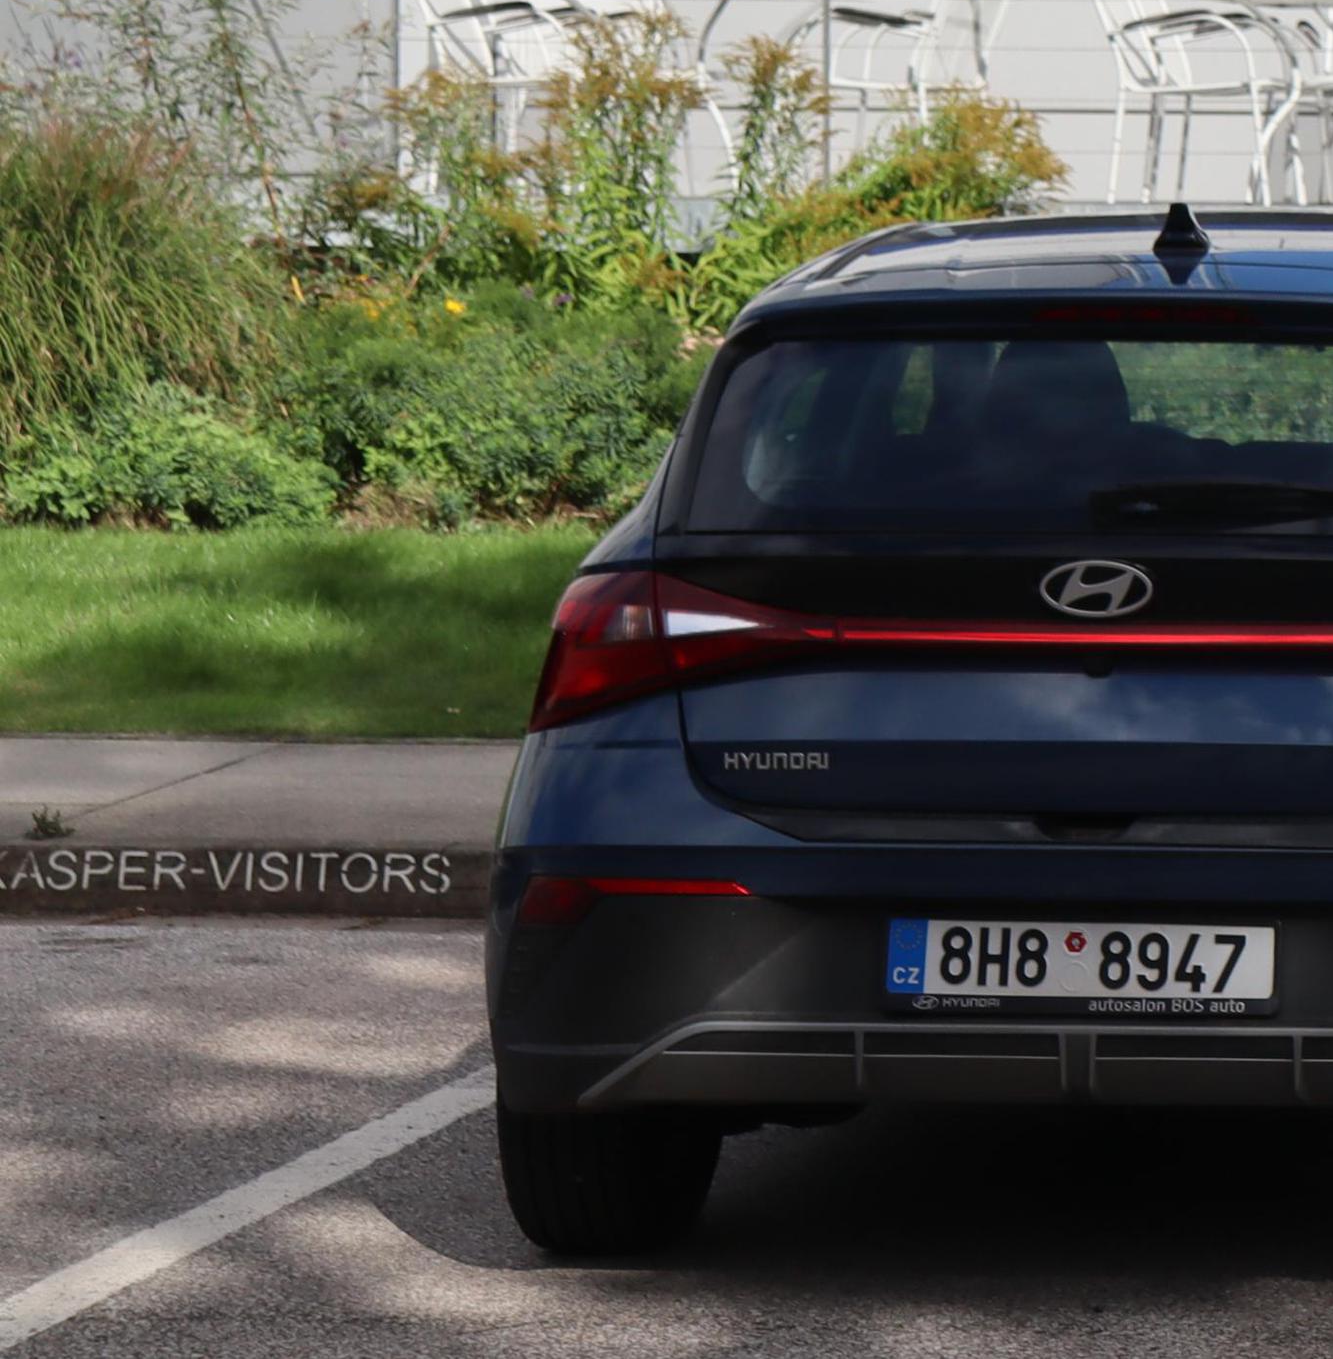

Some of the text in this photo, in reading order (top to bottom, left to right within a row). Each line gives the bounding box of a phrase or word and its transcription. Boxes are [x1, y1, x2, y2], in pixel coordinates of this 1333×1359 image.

[724, 752, 829, 770] HYUNDAI
[0, 849, 452, 894] ASPER-VISITORS
[939, 926, 1247, 992] 8H8 8947
[892, 966, 920, 984] CZ
[942, 997, 1001, 1008] HYUNDAI
[1088, 999, 1246, 1013] autosalon BOS auto
